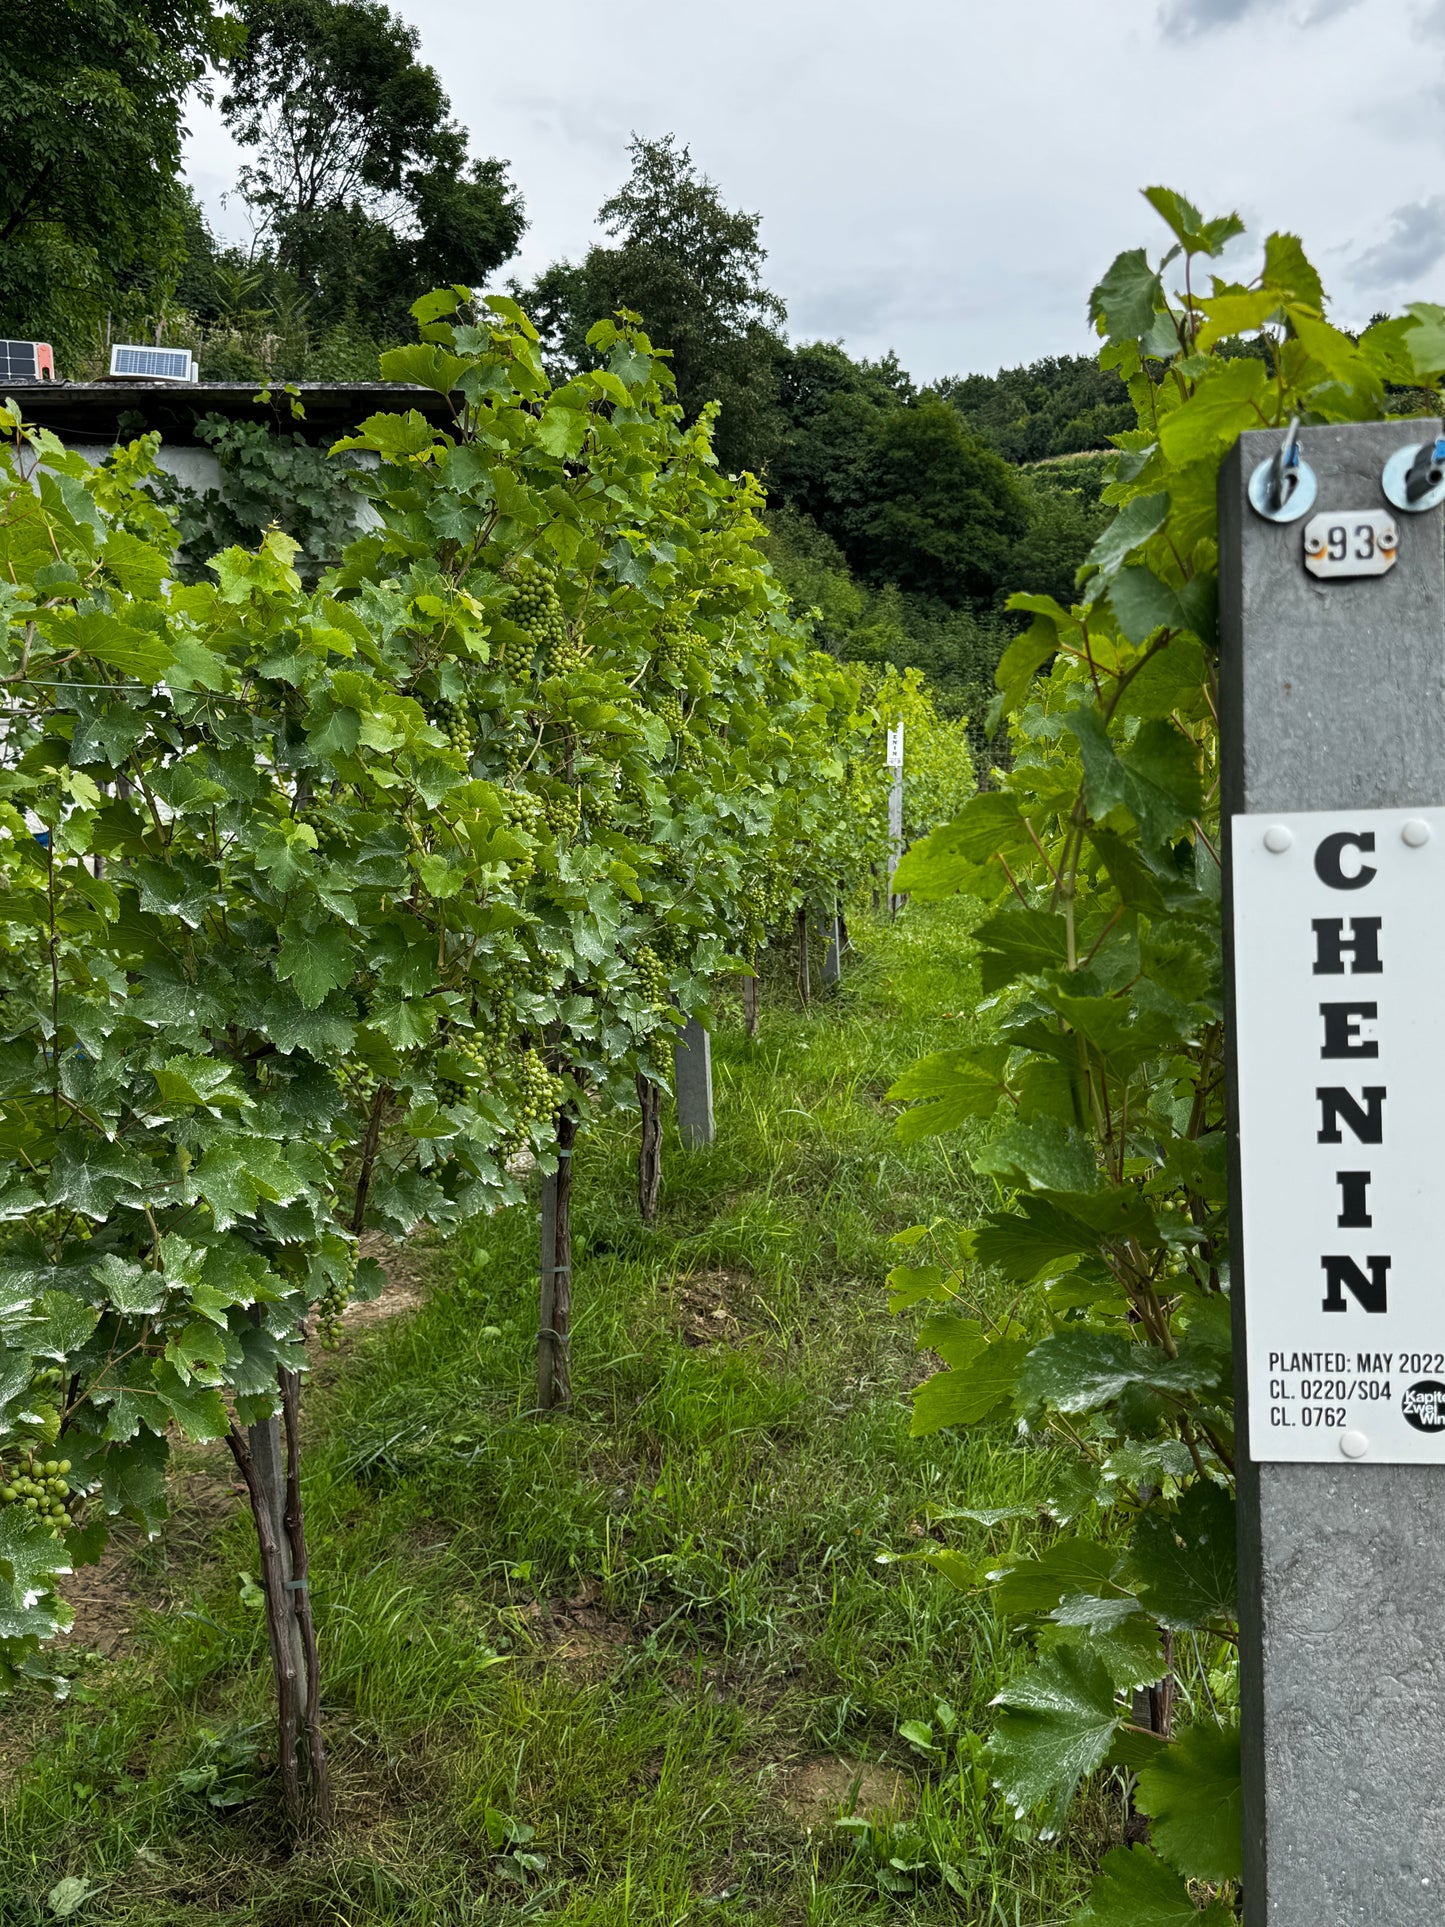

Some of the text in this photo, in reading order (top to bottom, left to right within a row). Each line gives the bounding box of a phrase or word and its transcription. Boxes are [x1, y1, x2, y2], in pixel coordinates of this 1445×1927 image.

[1327, 525, 1374, 561] 93
[1311, 831, 1392, 1314] CHENIN
[1269, 1352, 1445, 1374] PLANTED: MAY 2022
[1269, 1379, 1296, 1400] CL.
[1270, 1406, 1347, 1427] CL. 0762
